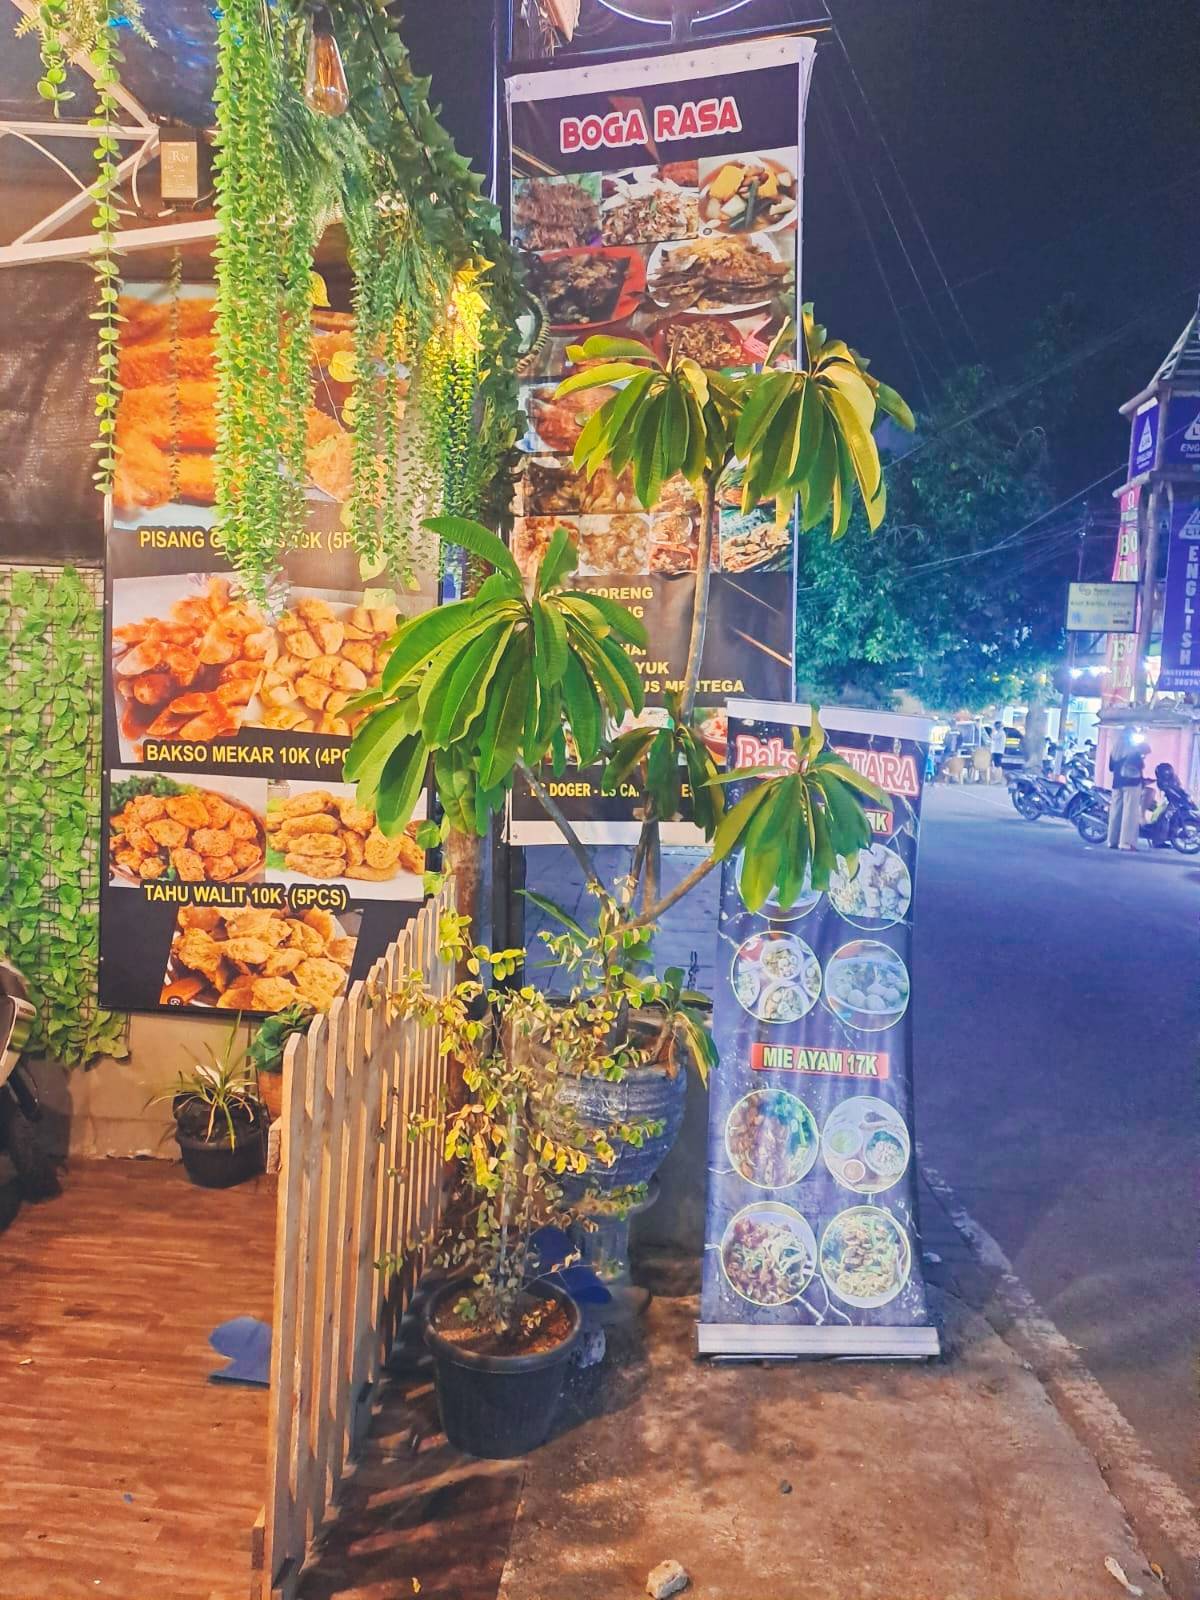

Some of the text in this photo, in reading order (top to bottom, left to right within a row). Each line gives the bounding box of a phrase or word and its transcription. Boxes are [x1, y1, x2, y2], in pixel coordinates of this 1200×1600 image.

[560, 96, 743, 153] BOGA RASA
[140, 531, 204, 549] PISANG
[1180, 545, 1199, 665] ENGLISH
[146, 744, 207, 762] BAKSO
[212, 746, 275, 763] MEKAR
[279, 748, 310, 764] 10K
[549, 783, 591, 797] DOGER
[144, 884, 347, 910] TAHU WALIT 10K (5PCS)
[763, 1046, 879, 1076] MIE AYAM 17K
